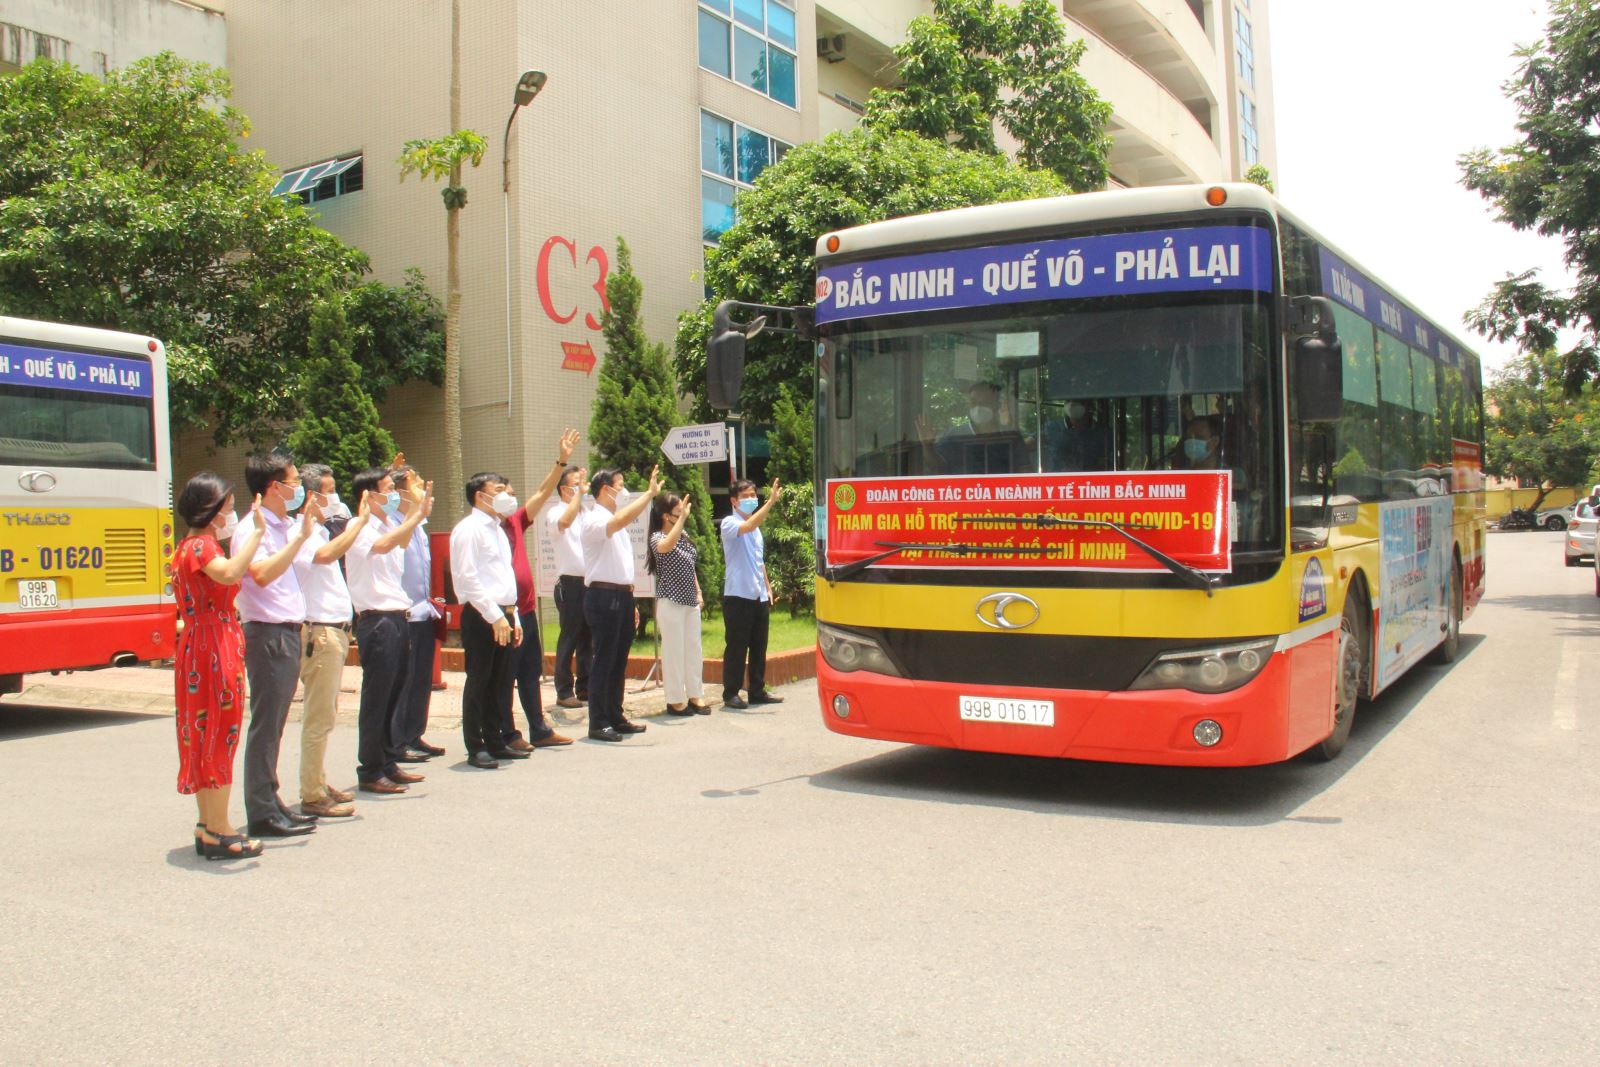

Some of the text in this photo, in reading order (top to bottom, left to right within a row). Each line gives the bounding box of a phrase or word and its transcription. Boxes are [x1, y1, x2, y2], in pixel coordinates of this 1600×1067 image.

[536, 235, 611, 330] C3
[835, 267, 881, 308] BẮC
[889, 267, 954, 301] NINH
[982, 248, 1040, 296] QUẾ
[1046, 250, 1084, 287] VÕ
[1115, 237, 1179, 283] PHẢ
[1188, 244, 1239, 284] LẠI
[24, 356, 54, 378] QUẾ
[57, 360, 76, 380] VÕ
[89, 363, 117, 385] PHẢ
[120, 369, 140, 390] LẠI
[866, 480, 1186, 502] ĐOÀN CÔNG TÁC CỦA NGÀNH Y TẾ TỈNH BẮC NINH
[3, 511, 71, 526] THACO
[836, 514, 873, 530] THAM
[877, 514, 901, 530] GIA
[905, 507, 924, 530] HỖ
[929, 512, 958, 534] TRỢ
[962, 508, 1016, 530] PHÒNG
[1084, 512, 1125, 534] DỊCH
[1130, 512, 1214, 530] COVID-19
[40, 545, 103, 570] 01620
[1046, 538, 1074, 560] CHÍ
[1080, 542, 1126, 560] MINH
[27, 581, 47, 593] 99B
[964, 700, 991, 718] 99B
